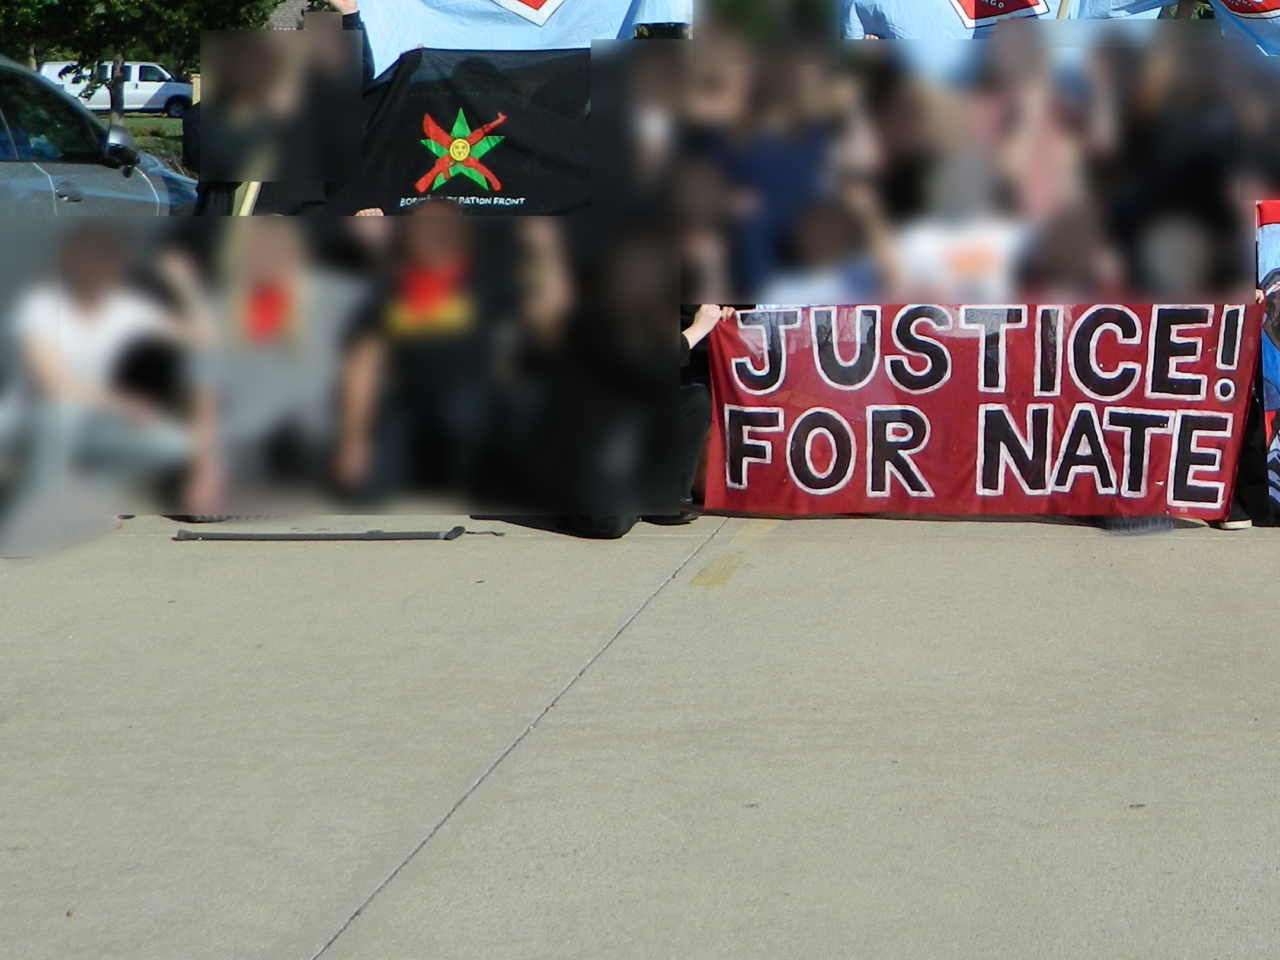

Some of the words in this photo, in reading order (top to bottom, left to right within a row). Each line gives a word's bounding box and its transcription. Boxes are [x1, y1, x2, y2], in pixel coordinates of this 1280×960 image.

[493, 197, 526, 206] FRONT
[731, 304, 1246, 403] JUSTICE!
[723, 404, 936, 498] FOR
[975, 403, 1234, 509] NATE
